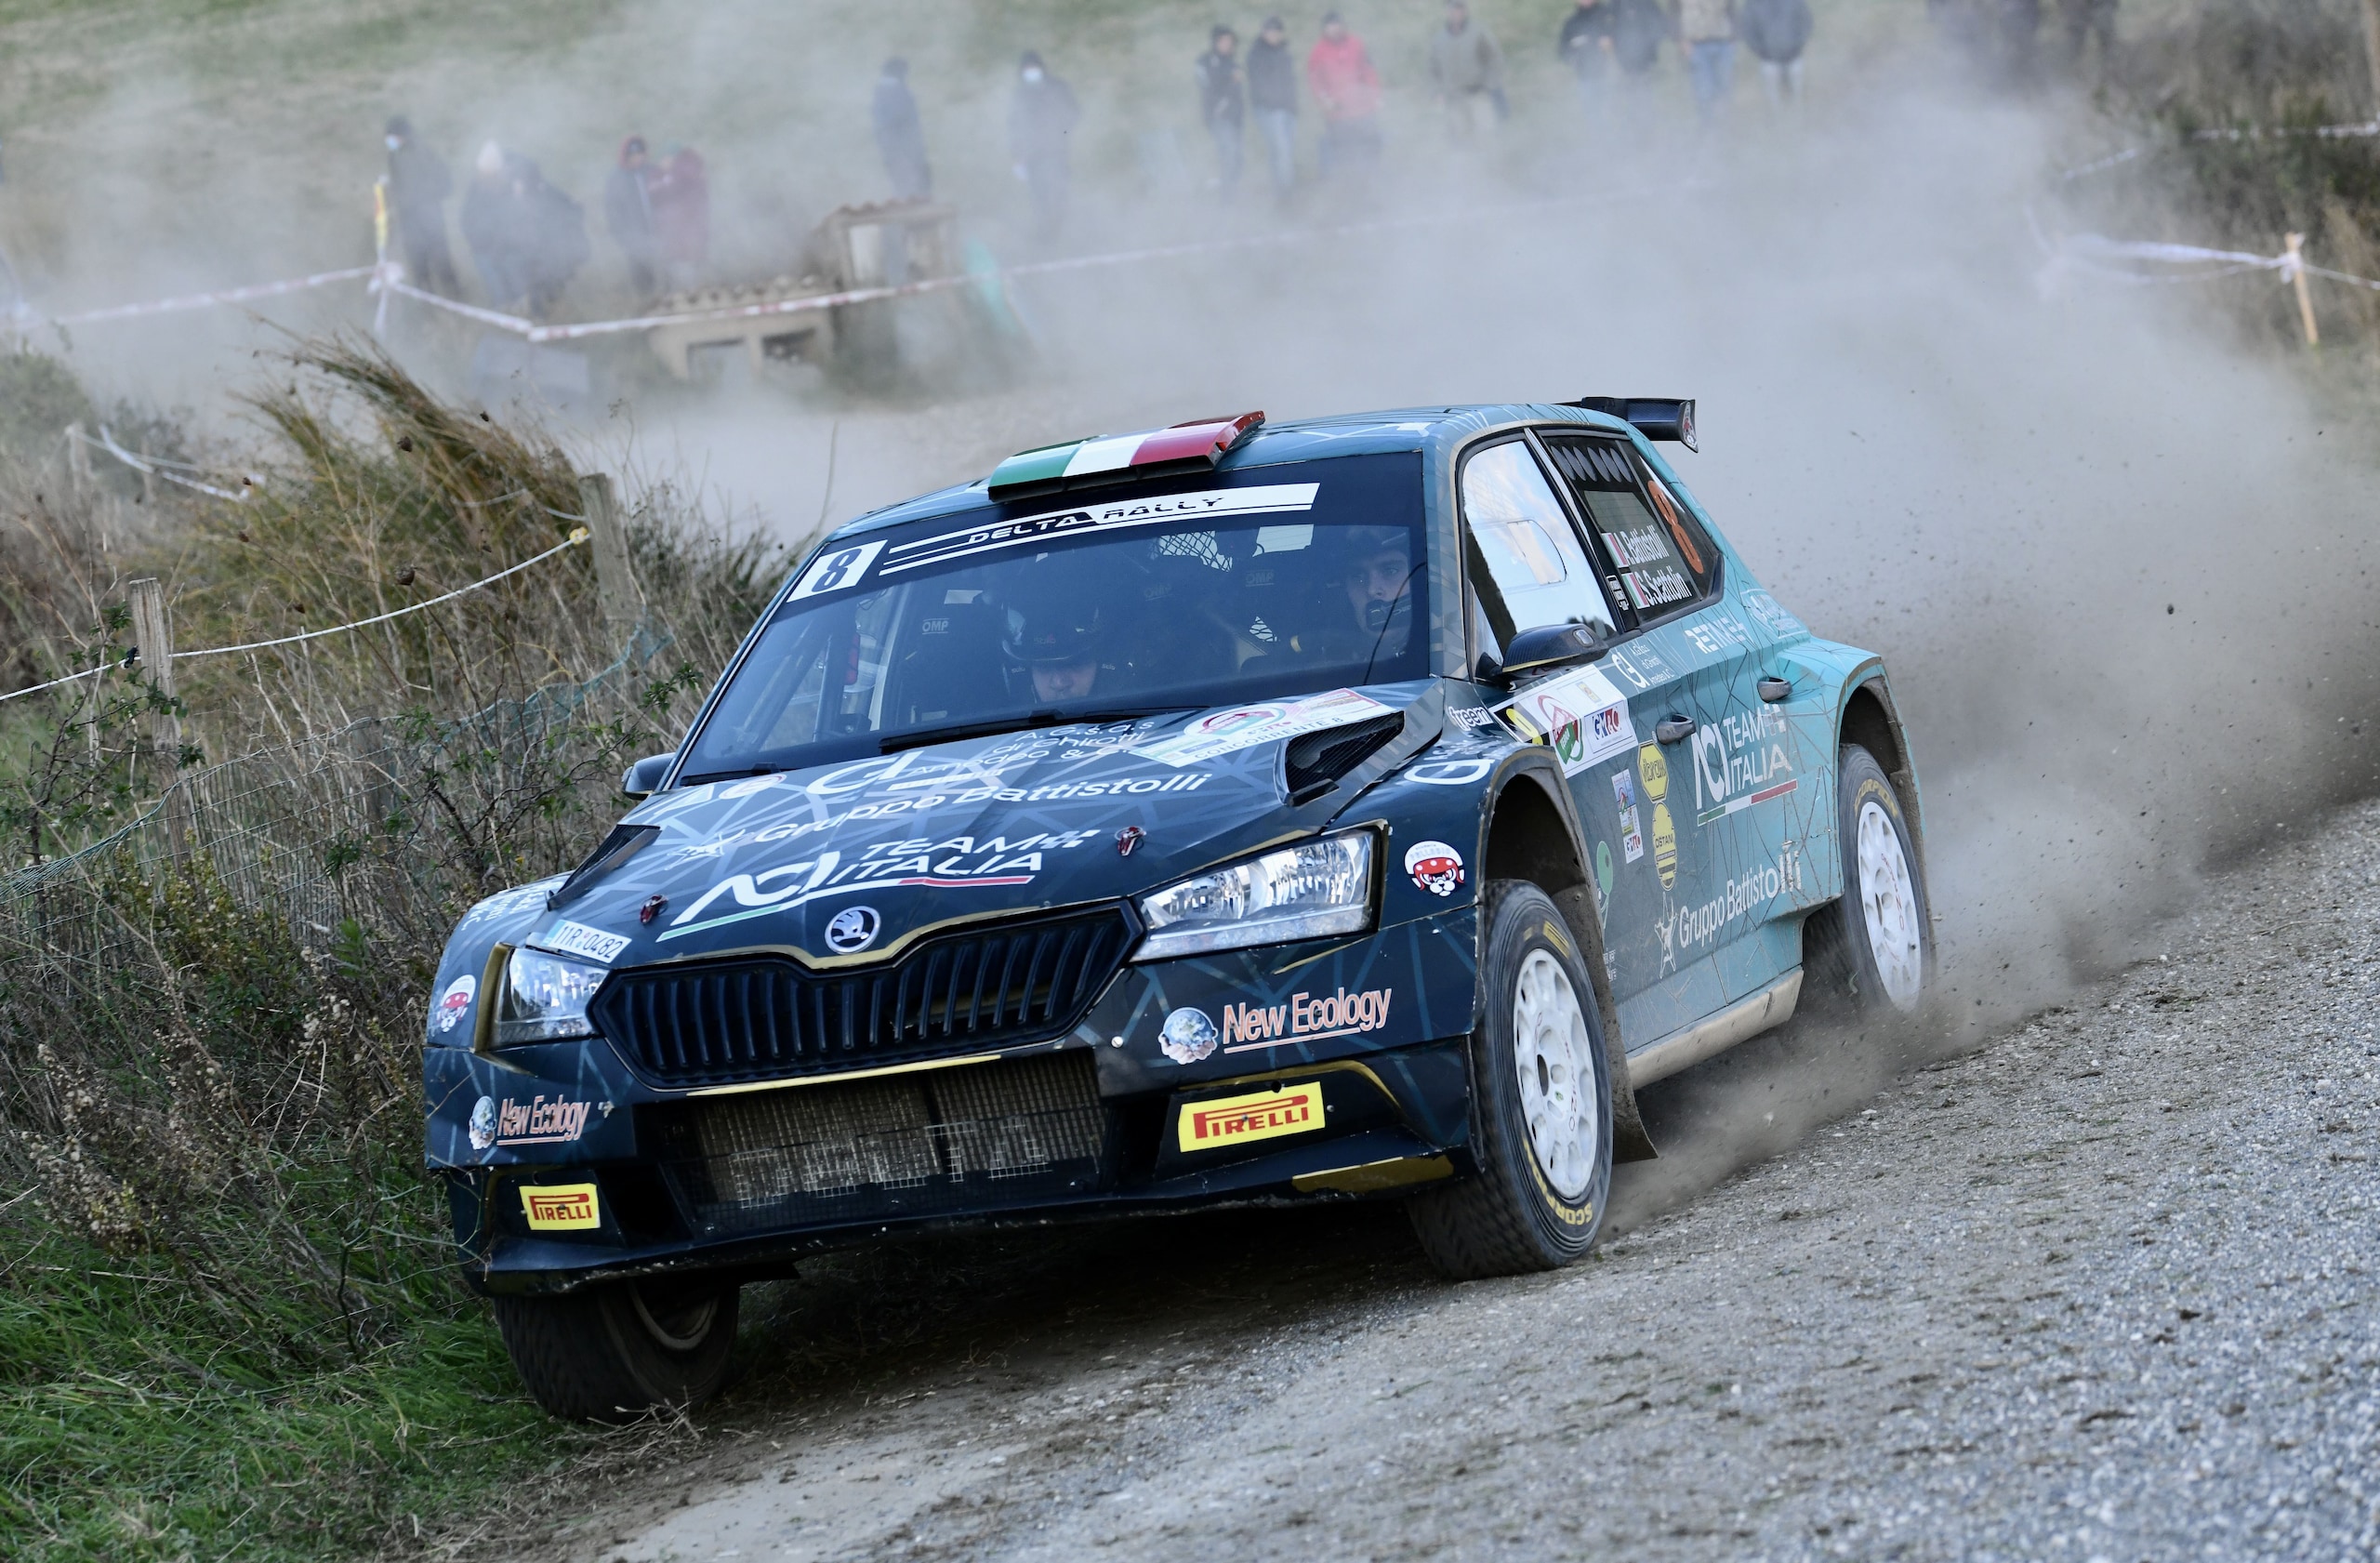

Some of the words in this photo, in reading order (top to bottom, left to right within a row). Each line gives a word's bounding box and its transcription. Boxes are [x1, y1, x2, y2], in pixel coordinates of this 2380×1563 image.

[968, 515, 1078, 544] DELTA
[1103, 496, 1226, 520] RALLY
[1647, 480, 1704, 574] 8
[812, 548, 863, 593] 8
[921, 619, 949, 632] OMP
[993, 740, 1025, 754] di
[1032, 731, 1144, 748] Ghirotti
[1194, 720, 1329, 759] CONCORRENTE
[1723, 707, 1765, 751] TEAM
[909, 749, 1050, 775] Amedeo
[1061, 748, 1086, 761] &
[1730, 744, 1792, 793] ITALIA
[754, 795, 946, 842] Gruppo
[953, 773, 1212, 806] Battistolli
[827, 853, 1042, 881] ITALIA
[866, 835, 1044, 859] TEAM
[1679, 895, 1726, 948] Gruppo
[1726, 846, 1802, 921] Battistolli
[553, 925, 583, 948] 11R
[583, 934, 624, 959] 0482
[1223, 1003, 1287, 1046] New
[1291, 987, 1393, 1031] Ecology
[497, 1098, 532, 1136] New
[530, 1094, 591, 1142] Ecology
[1193, 1094, 1309, 1140] PIRELLI
[529, 1193, 592, 1221] PIRELLI
